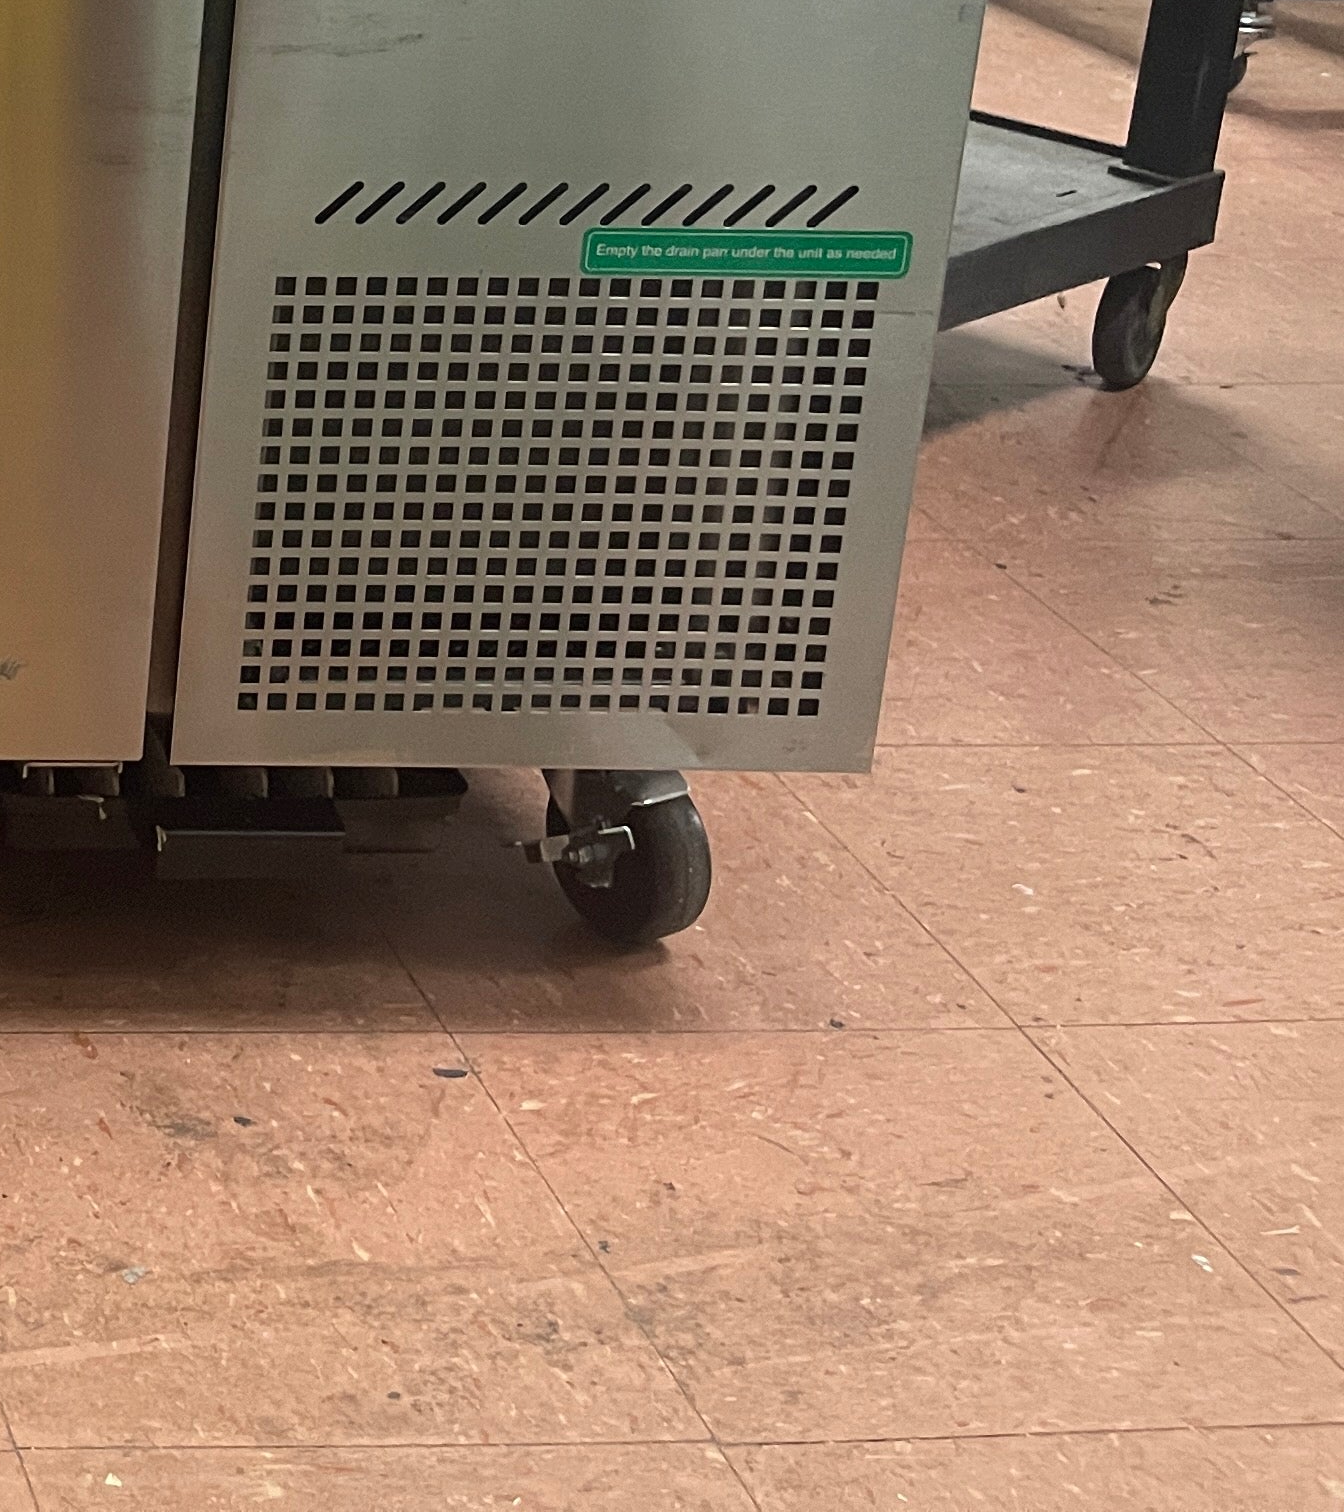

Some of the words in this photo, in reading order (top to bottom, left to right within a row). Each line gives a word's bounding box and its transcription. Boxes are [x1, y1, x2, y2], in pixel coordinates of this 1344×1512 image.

[595, 243, 639, 259] Empty
[641, 244, 663, 257] the
[665, 245, 699, 257] drain
[702, 247, 728, 260] pan
[731, 246, 772, 258] under
[773, 246, 794, 259] the
[798, 247, 823, 259] unit
[826, 249, 843, 259] as
[845, 248, 897, 261] needed
